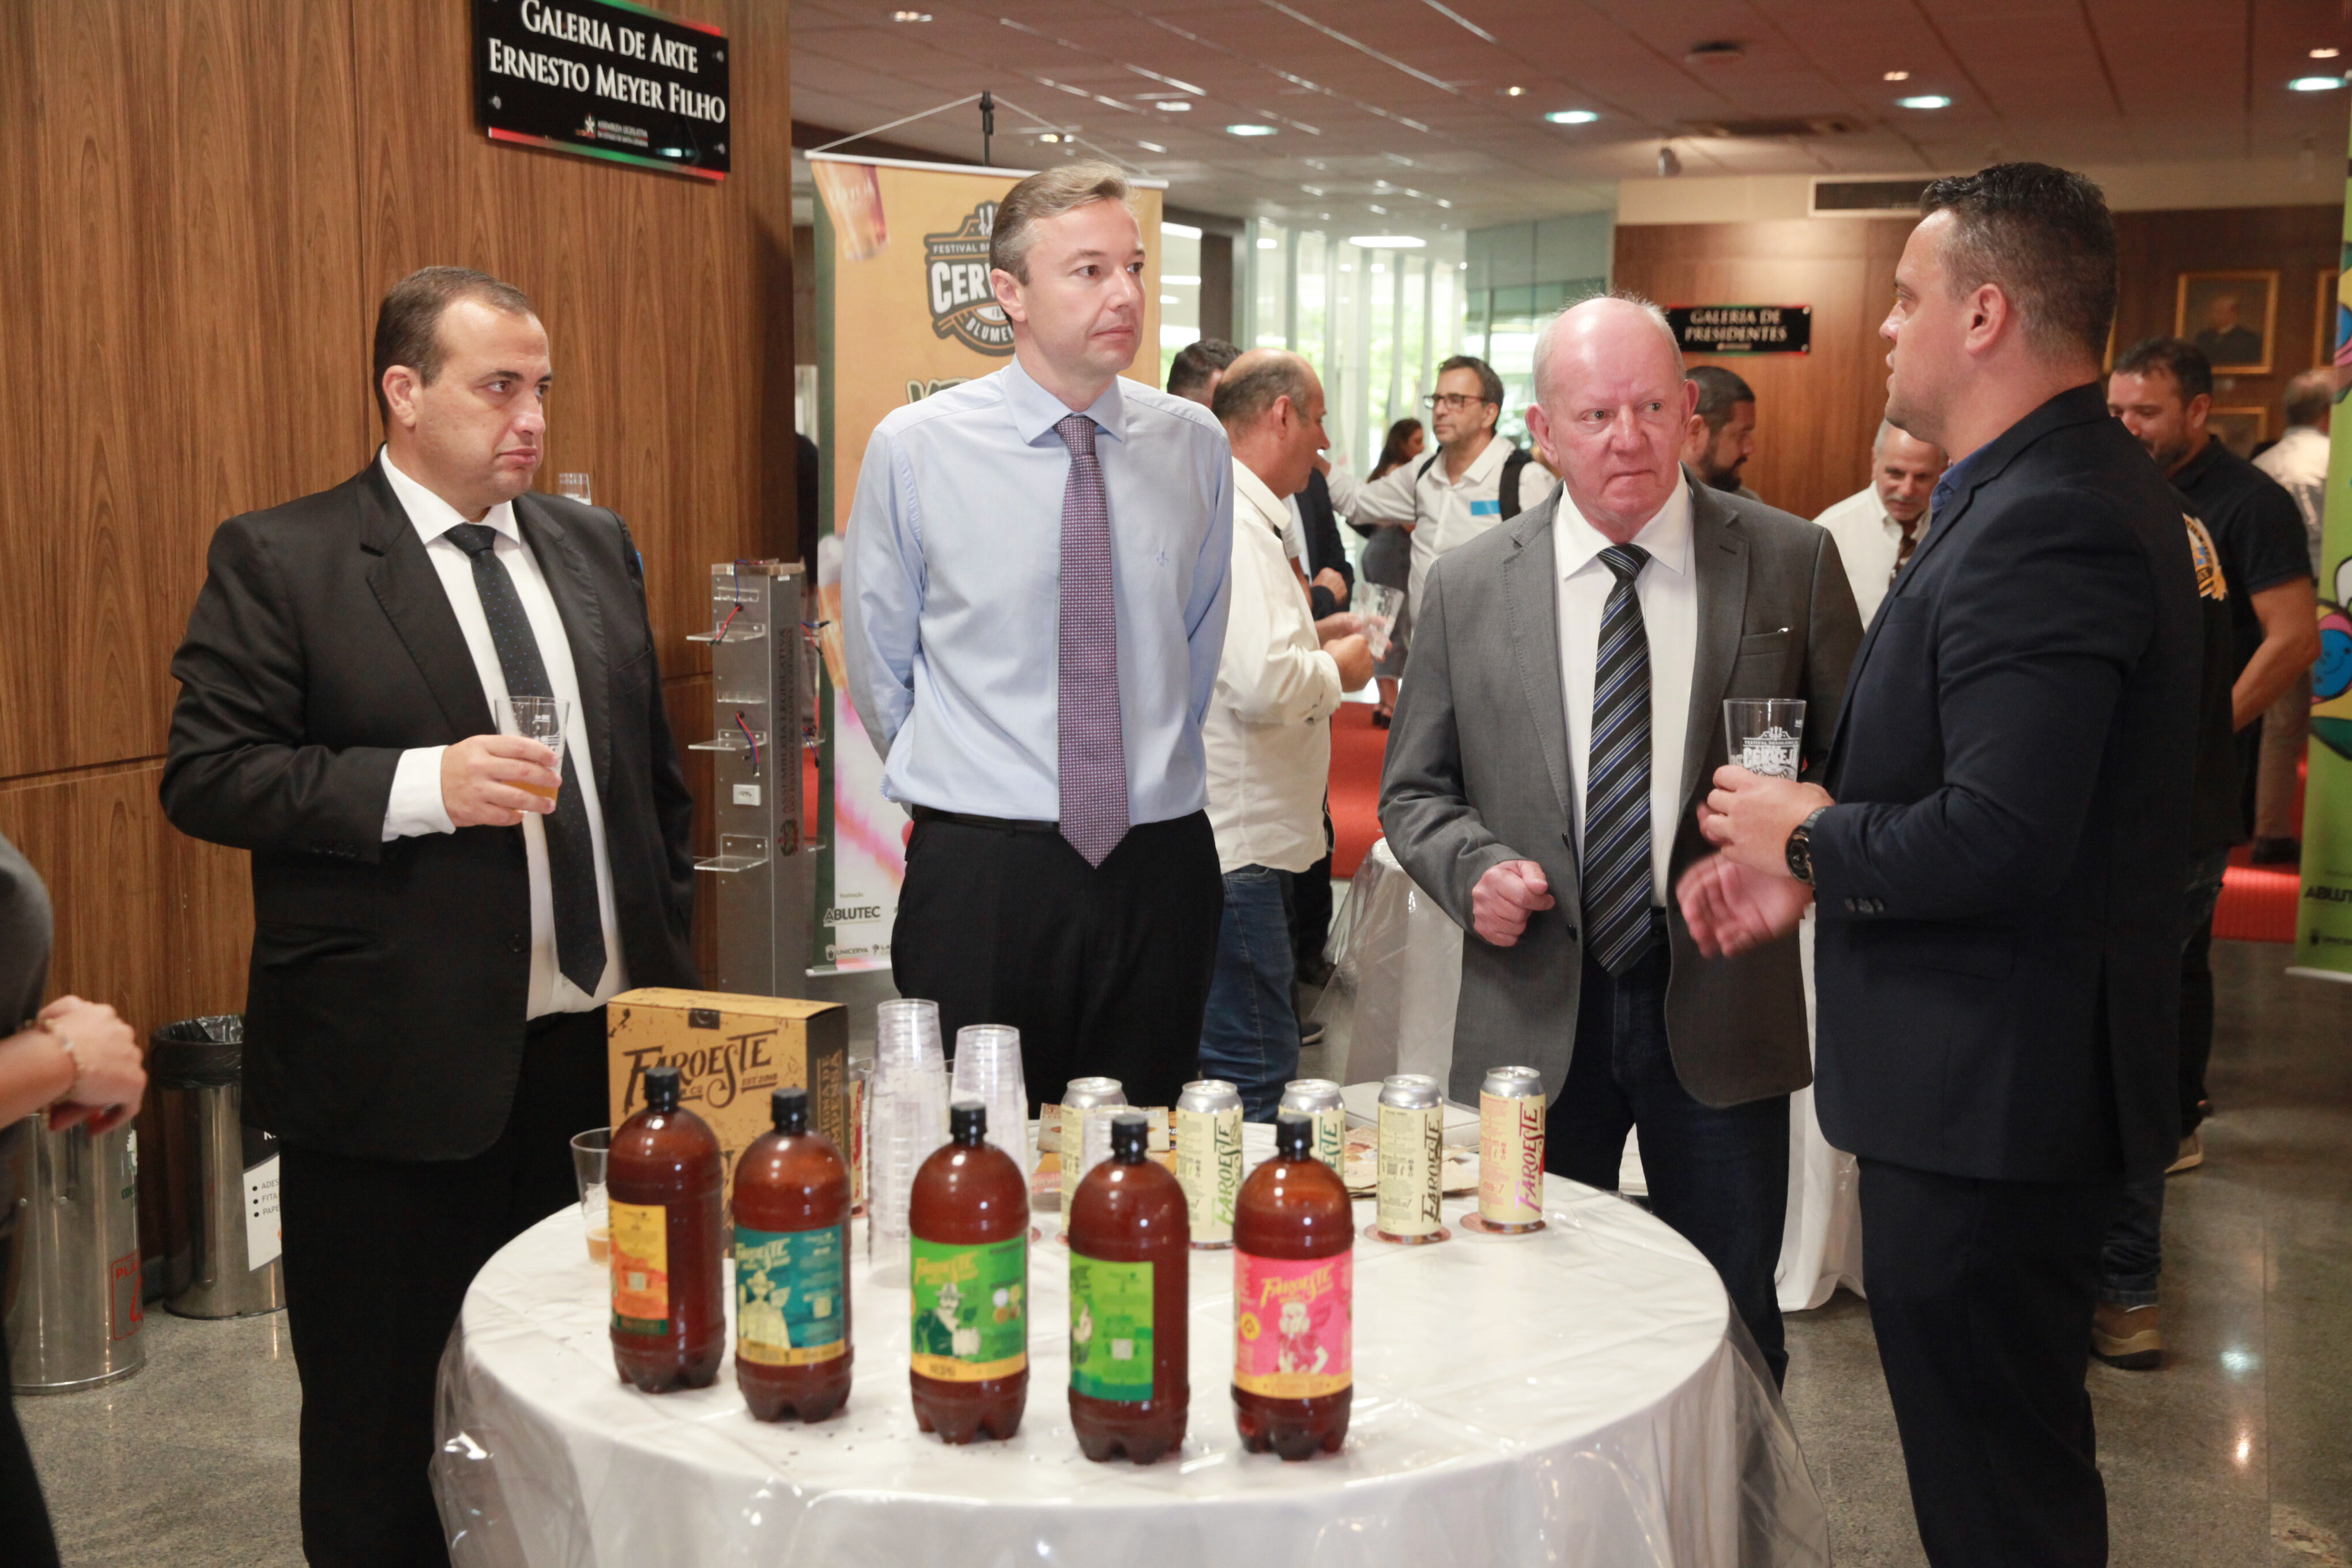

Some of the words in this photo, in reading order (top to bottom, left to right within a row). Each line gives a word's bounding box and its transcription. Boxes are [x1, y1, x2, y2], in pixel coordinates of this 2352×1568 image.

[521, 0, 614, 52] GALERIA
[619, 27, 646, 60] DE
[650, 32, 699, 74] ARTE
[488, 37, 590, 92] ERNESTO
[595, 63, 665, 111] MEYER
[669, 81, 726, 123] FILHO
[933, 244, 978, 254] FESTIVAL
[824, 906, 881, 921] ABLUTEC
[836, 948, 869, 956] UNICERVA
[623, 1028, 778, 1115] FAROESTE
[1211, 1117, 1241, 1227] FAROESTE
[1318, 1114, 1341, 1170] ESTE
[1514, 1101, 1544, 1213] FAROESTE
[262, 1193, 277, 1203] FITA
